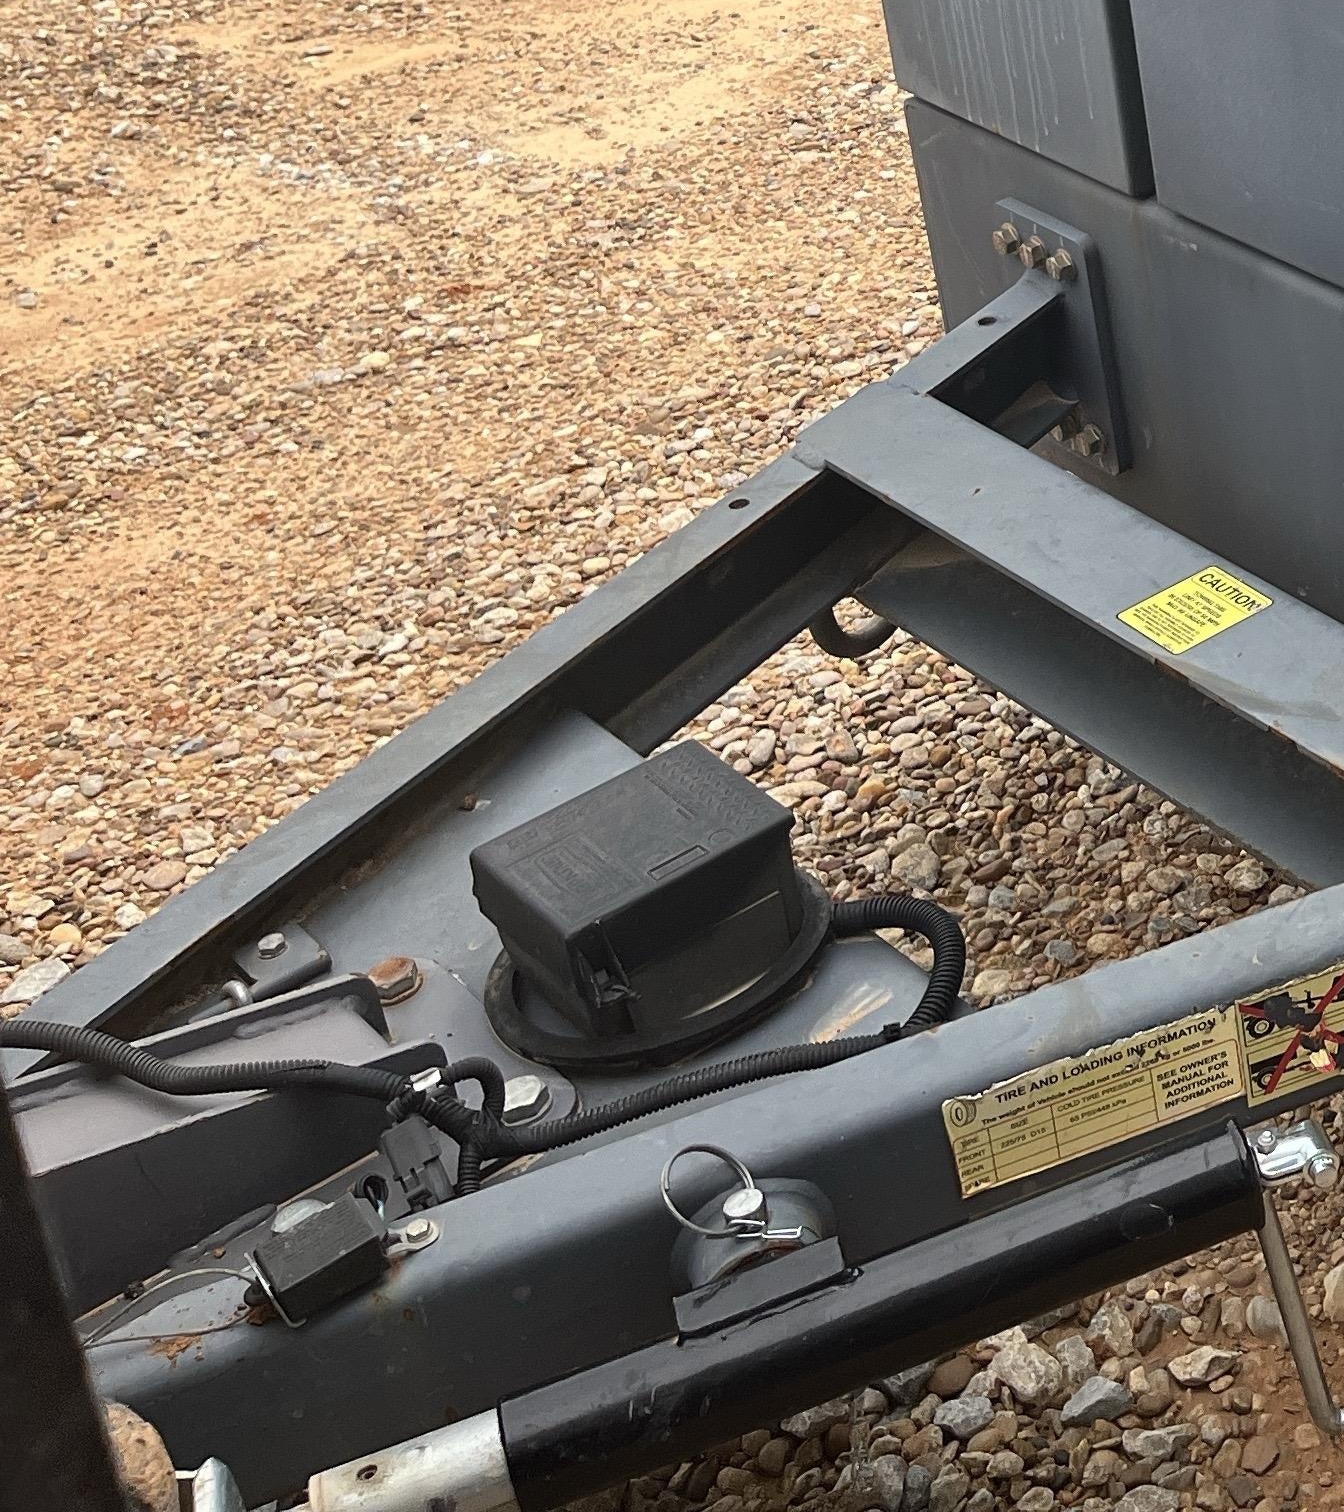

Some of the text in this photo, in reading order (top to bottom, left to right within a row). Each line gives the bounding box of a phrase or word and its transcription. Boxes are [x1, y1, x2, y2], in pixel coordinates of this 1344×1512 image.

[1199, 573, 1262, 611] CAUTION
[994, 1017, 1216, 1104] TIRE AND LOADING INFORMATION
[1156, 1050, 1226, 1081] SEE OWNER'S
[1161, 1059, 1228, 1090] MANUAL FOR
[981, 1115, 996, 1125] The
[997, 1104, 1026, 1120] weight
[1027, 1100, 1036, 1108] of
[1067, 1079, 1094, 1094] should
[1096, 1074, 1110, 1084] not
[1057, 1099, 1080, 1112] COLD
[1081, 1092, 1099, 1103] TIRE
[1101, 1075, 1145, 1096] PRESSURE
[1164, 1077, 1233, 1110] INFORMATION
[1166, 1070, 1227, 1099] ADDITIONAL
[957, 1148, 986, 1164] FRONT
